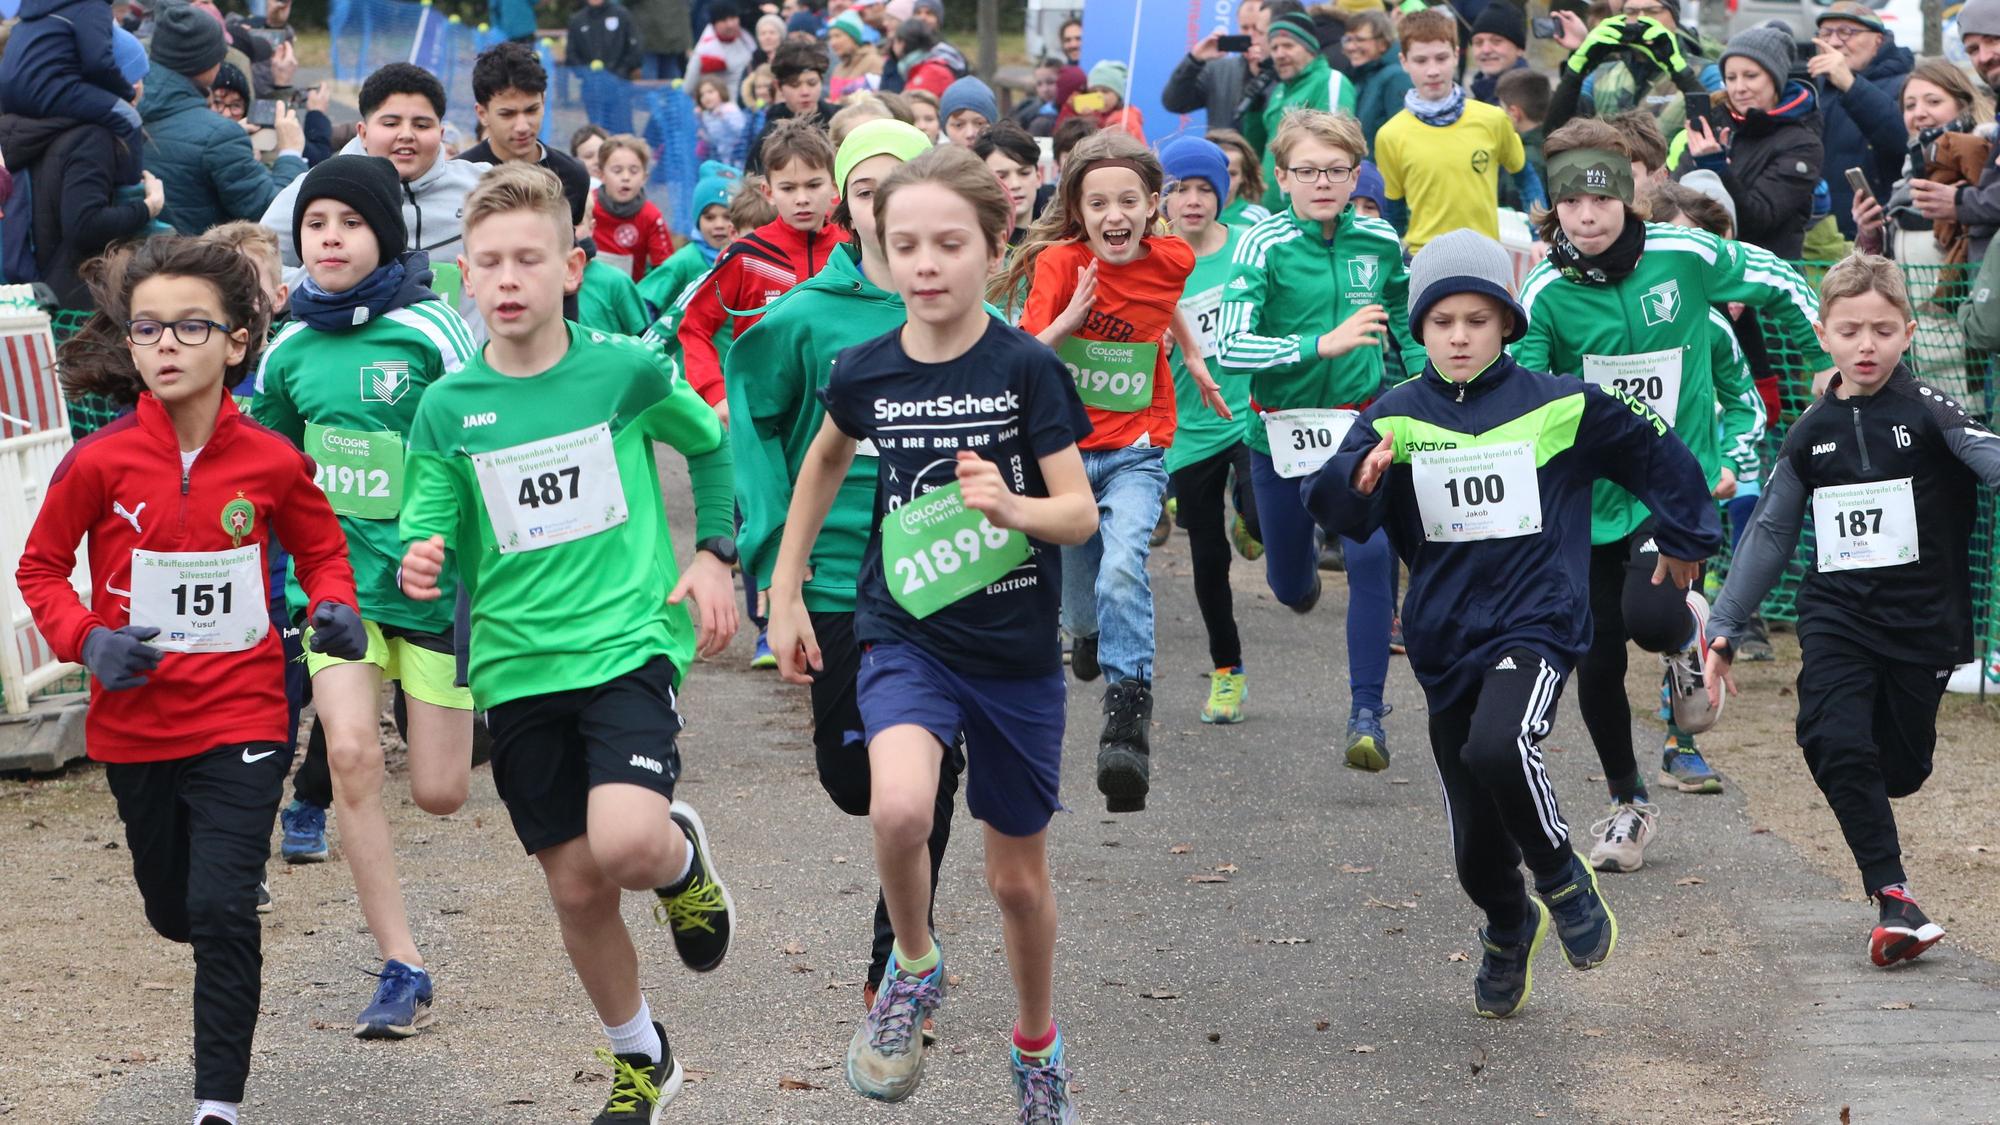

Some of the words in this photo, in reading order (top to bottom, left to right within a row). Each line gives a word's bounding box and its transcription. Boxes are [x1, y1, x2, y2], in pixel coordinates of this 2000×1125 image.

[1091, 347, 1134, 357] COLOGNE
[873, 390, 1020, 422] SportScheck
[462, 412, 497, 428] JAKO
[327, 435, 370, 450] COLOGNE
[902, 437, 925, 448] BRE
[934, 437, 959, 448] DRS
[967, 434, 990, 447] ERF
[1291, 428, 1332, 450] 310
[1892, 425, 1911, 448] 16
[340, 447, 370, 457] TIMING
[495, 445, 554, 466] Raiffeisenbank
[555, 438, 587, 452] Voreifel
[1430, 454, 1482, 465] Raiffeisenbank
[1483, 450, 1511, 460] Voreifel
[1812, 442, 1836, 455] JAKO
[518, 455, 569, 473] Silvesterlauf
[1010, 454, 1025, 492] 2023
[1448, 463, 1494, 474] Silvesterlauf
[518, 466, 580, 508] 487
[1444, 474, 1505, 507] 100
[905, 493, 960, 525] COLOGNE
[924, 505, 963, 527] TIMING
[1465, 510, 1488, 518] Jakob
[1834, 508, 1883, 537] 187
[158, 559, 218, 568] Raiffeisenbank
[221, 555, 245, 566] Voreifel
[895, 517, 1009, 595] 21898
[180, 570, 230, 579] Silvesterlauf
[986, 576, 1038, 595] EDITION
[171, 582, 232, 616] 151
[191, 620, 216, 628] Yusuf
[629, 754, 663, 774] JAKO
